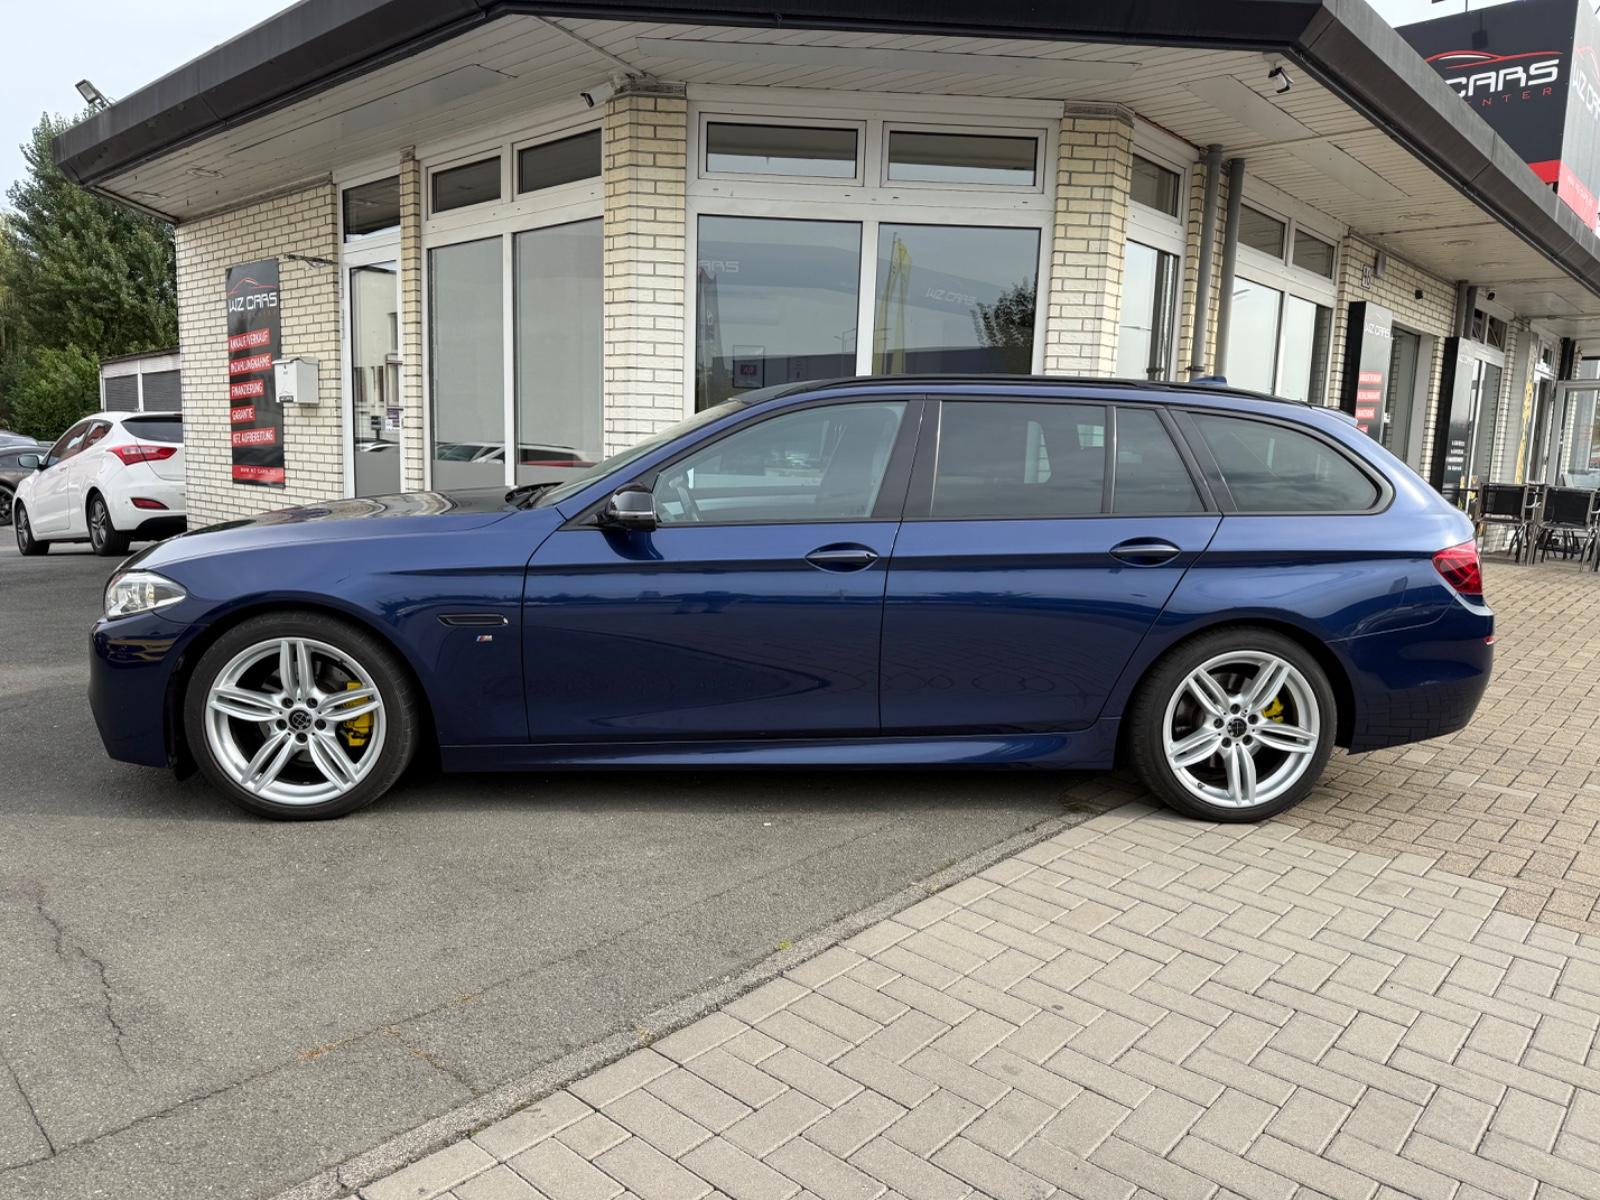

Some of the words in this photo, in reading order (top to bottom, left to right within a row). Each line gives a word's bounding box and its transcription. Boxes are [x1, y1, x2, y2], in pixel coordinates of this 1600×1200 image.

[1445, 59, 1560, 98] CARS
[1466, 87, 1553, 106] NTER
[229, 296, 245, 313] WZ
[246, 292, 278, 310] CARS
